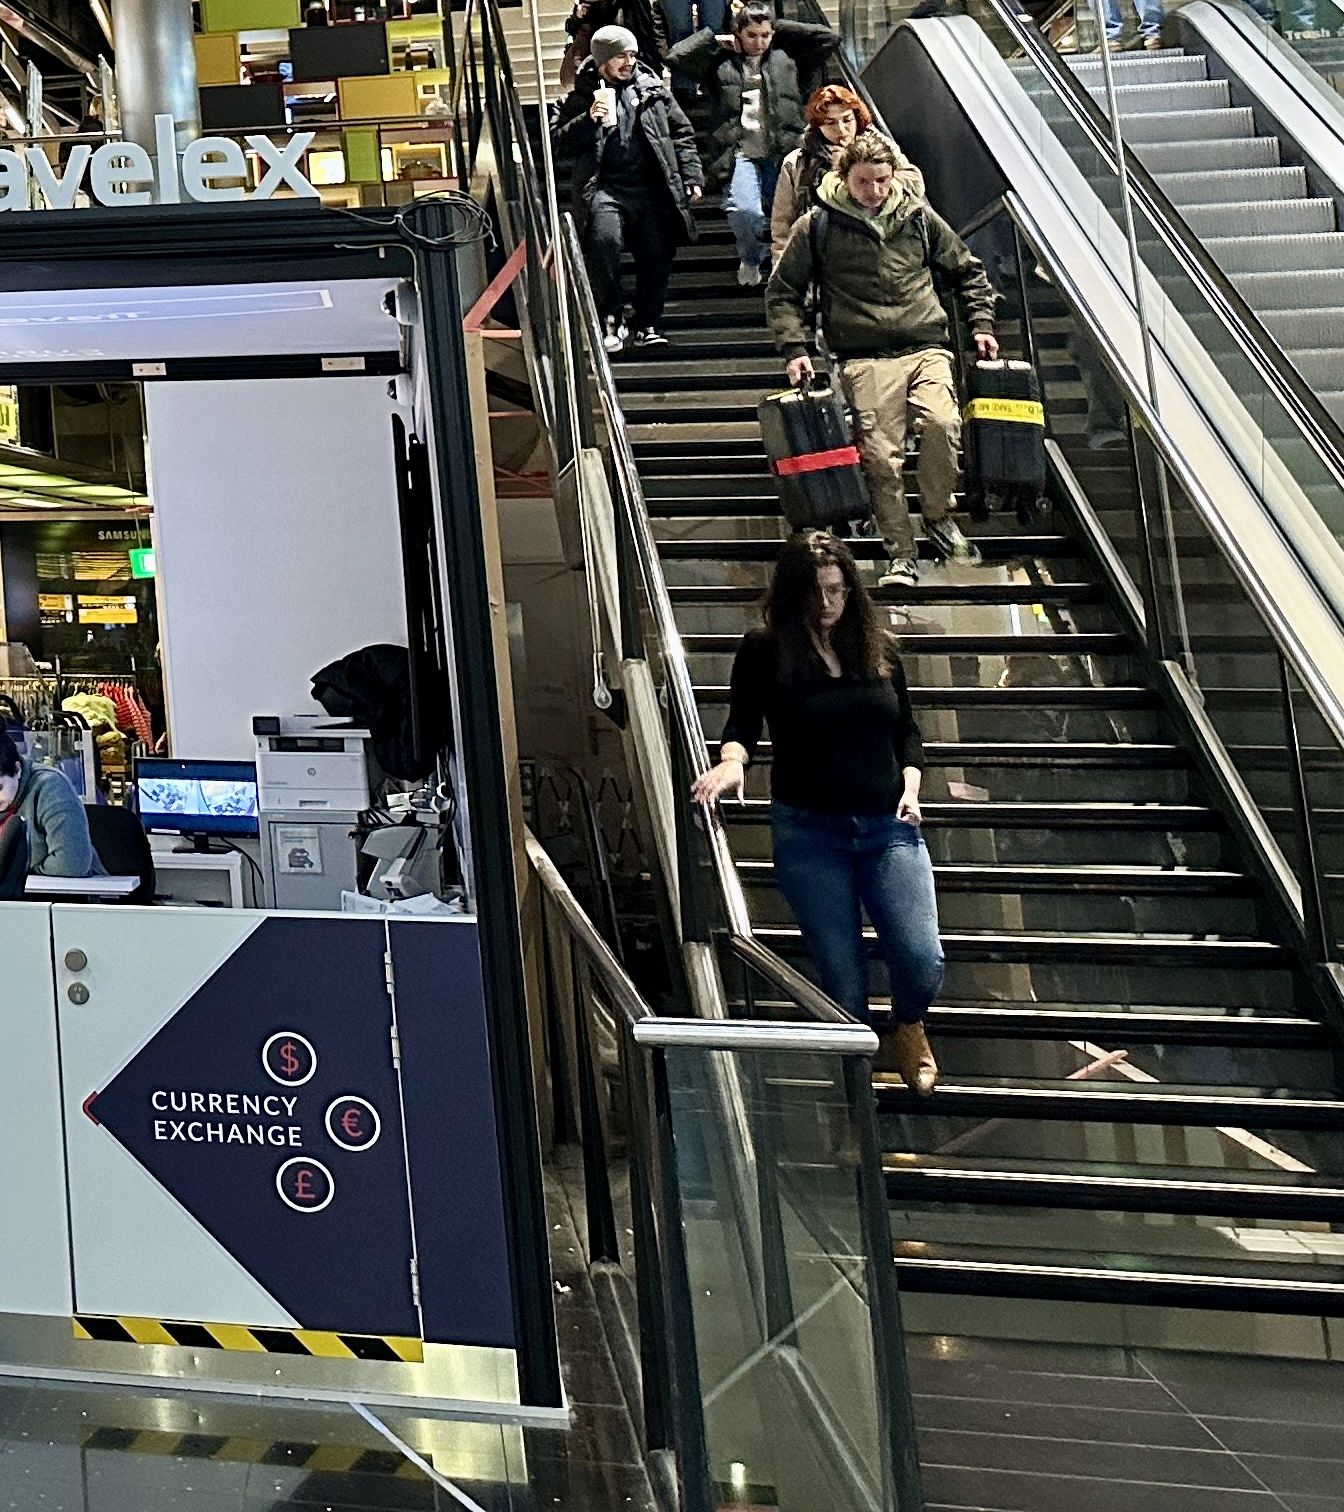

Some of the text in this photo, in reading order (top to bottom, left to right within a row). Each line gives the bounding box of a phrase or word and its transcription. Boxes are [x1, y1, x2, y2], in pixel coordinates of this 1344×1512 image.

[280, 1041, 300, 1076] $
[151, 1090, 298, 1117] CURRENCY
[154, 1120, 303, 1147] EXCHANGE
[341, 1108, 363, 1138] €
[294, 1169, 316, 1199] £
